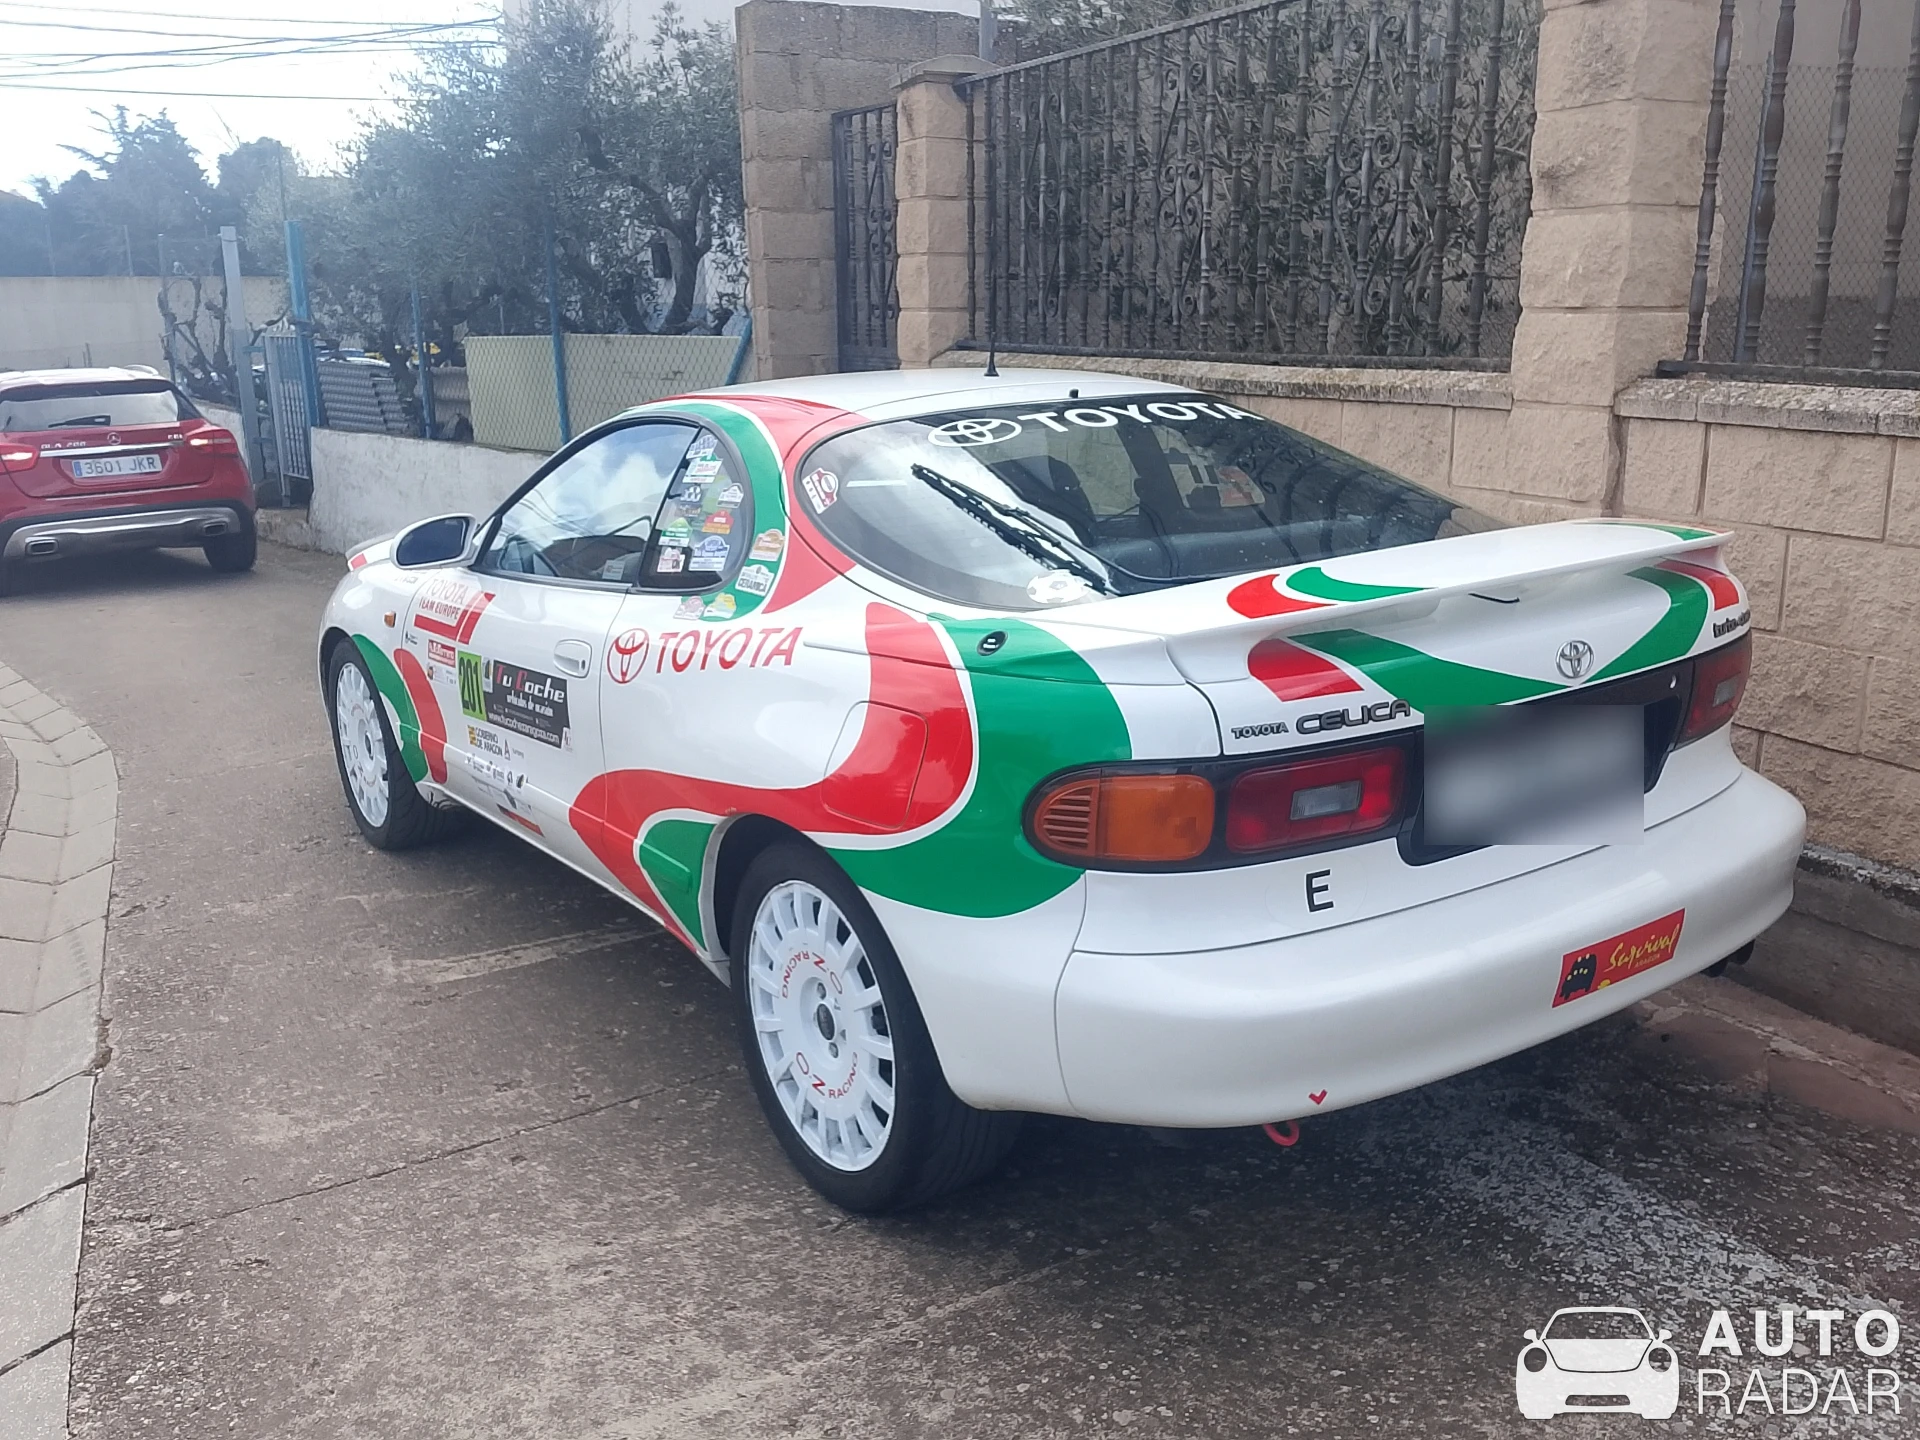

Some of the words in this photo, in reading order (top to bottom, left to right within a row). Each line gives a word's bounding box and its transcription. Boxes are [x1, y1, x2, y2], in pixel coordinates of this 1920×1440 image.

[1018, 401, 1264, 434] TOYOTA
[84, 460, 122, 475] 3601
[130, 457, 157, 472] JKR
[419, 596, 436, 612] TEAM
[434, 601, 461, 620] EUROPE
[426, 579, 469, 605] TOYOTA
[656, 627, 803, 674] TOYOTA
[458, 656, 483, 715] 201
[496, 664, 512, 688] Tu
[515, 670, 565, 703] Coche
[1231, 722, 1289, 740] TOYOTA
[1296, 699, 1411, 735] CELICA
[1306, 869, 1334, 912] E
[782, 950, 810, 999] RACING
[828, 1051, 858, 1100] RACING
